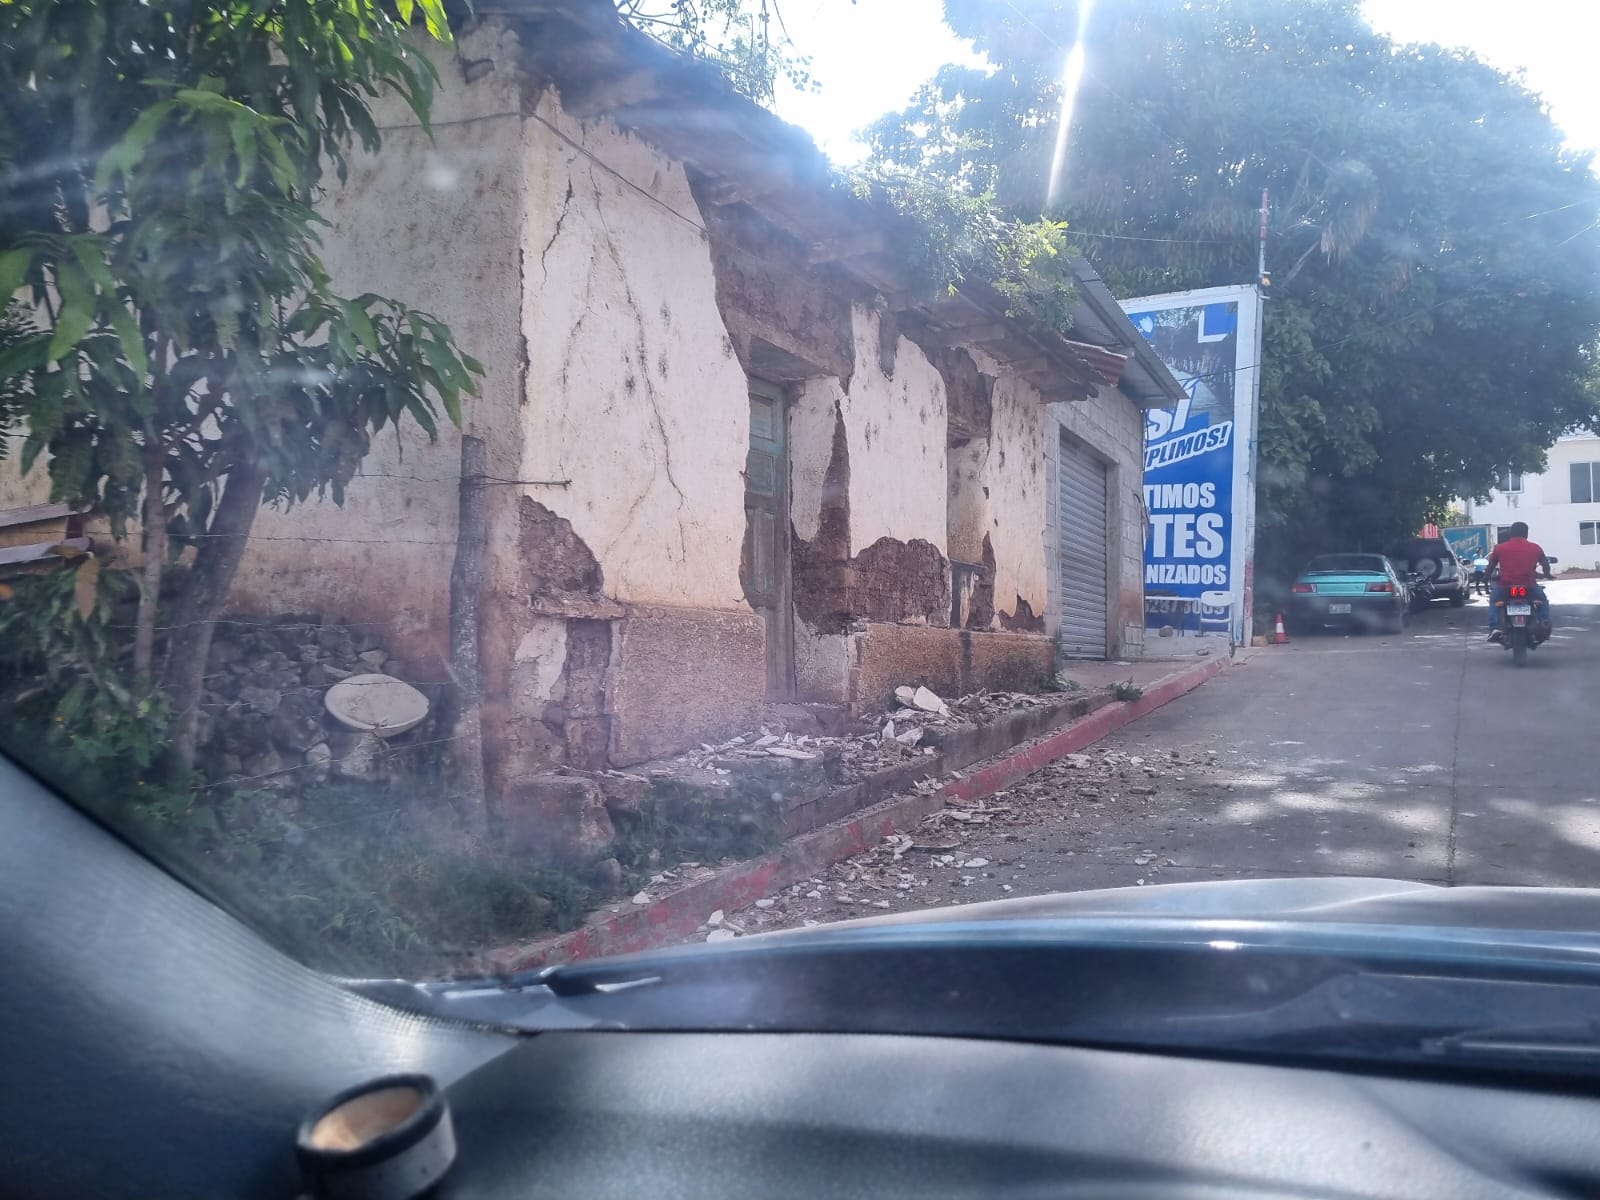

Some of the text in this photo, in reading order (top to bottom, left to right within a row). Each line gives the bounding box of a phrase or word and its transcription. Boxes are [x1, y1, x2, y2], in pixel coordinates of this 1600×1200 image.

[1145, 424, 1229, 467] PLIMOS!
[1143, 512, 1224, 559] TES
[1145, 564, 1227, 585] NIZADOS
